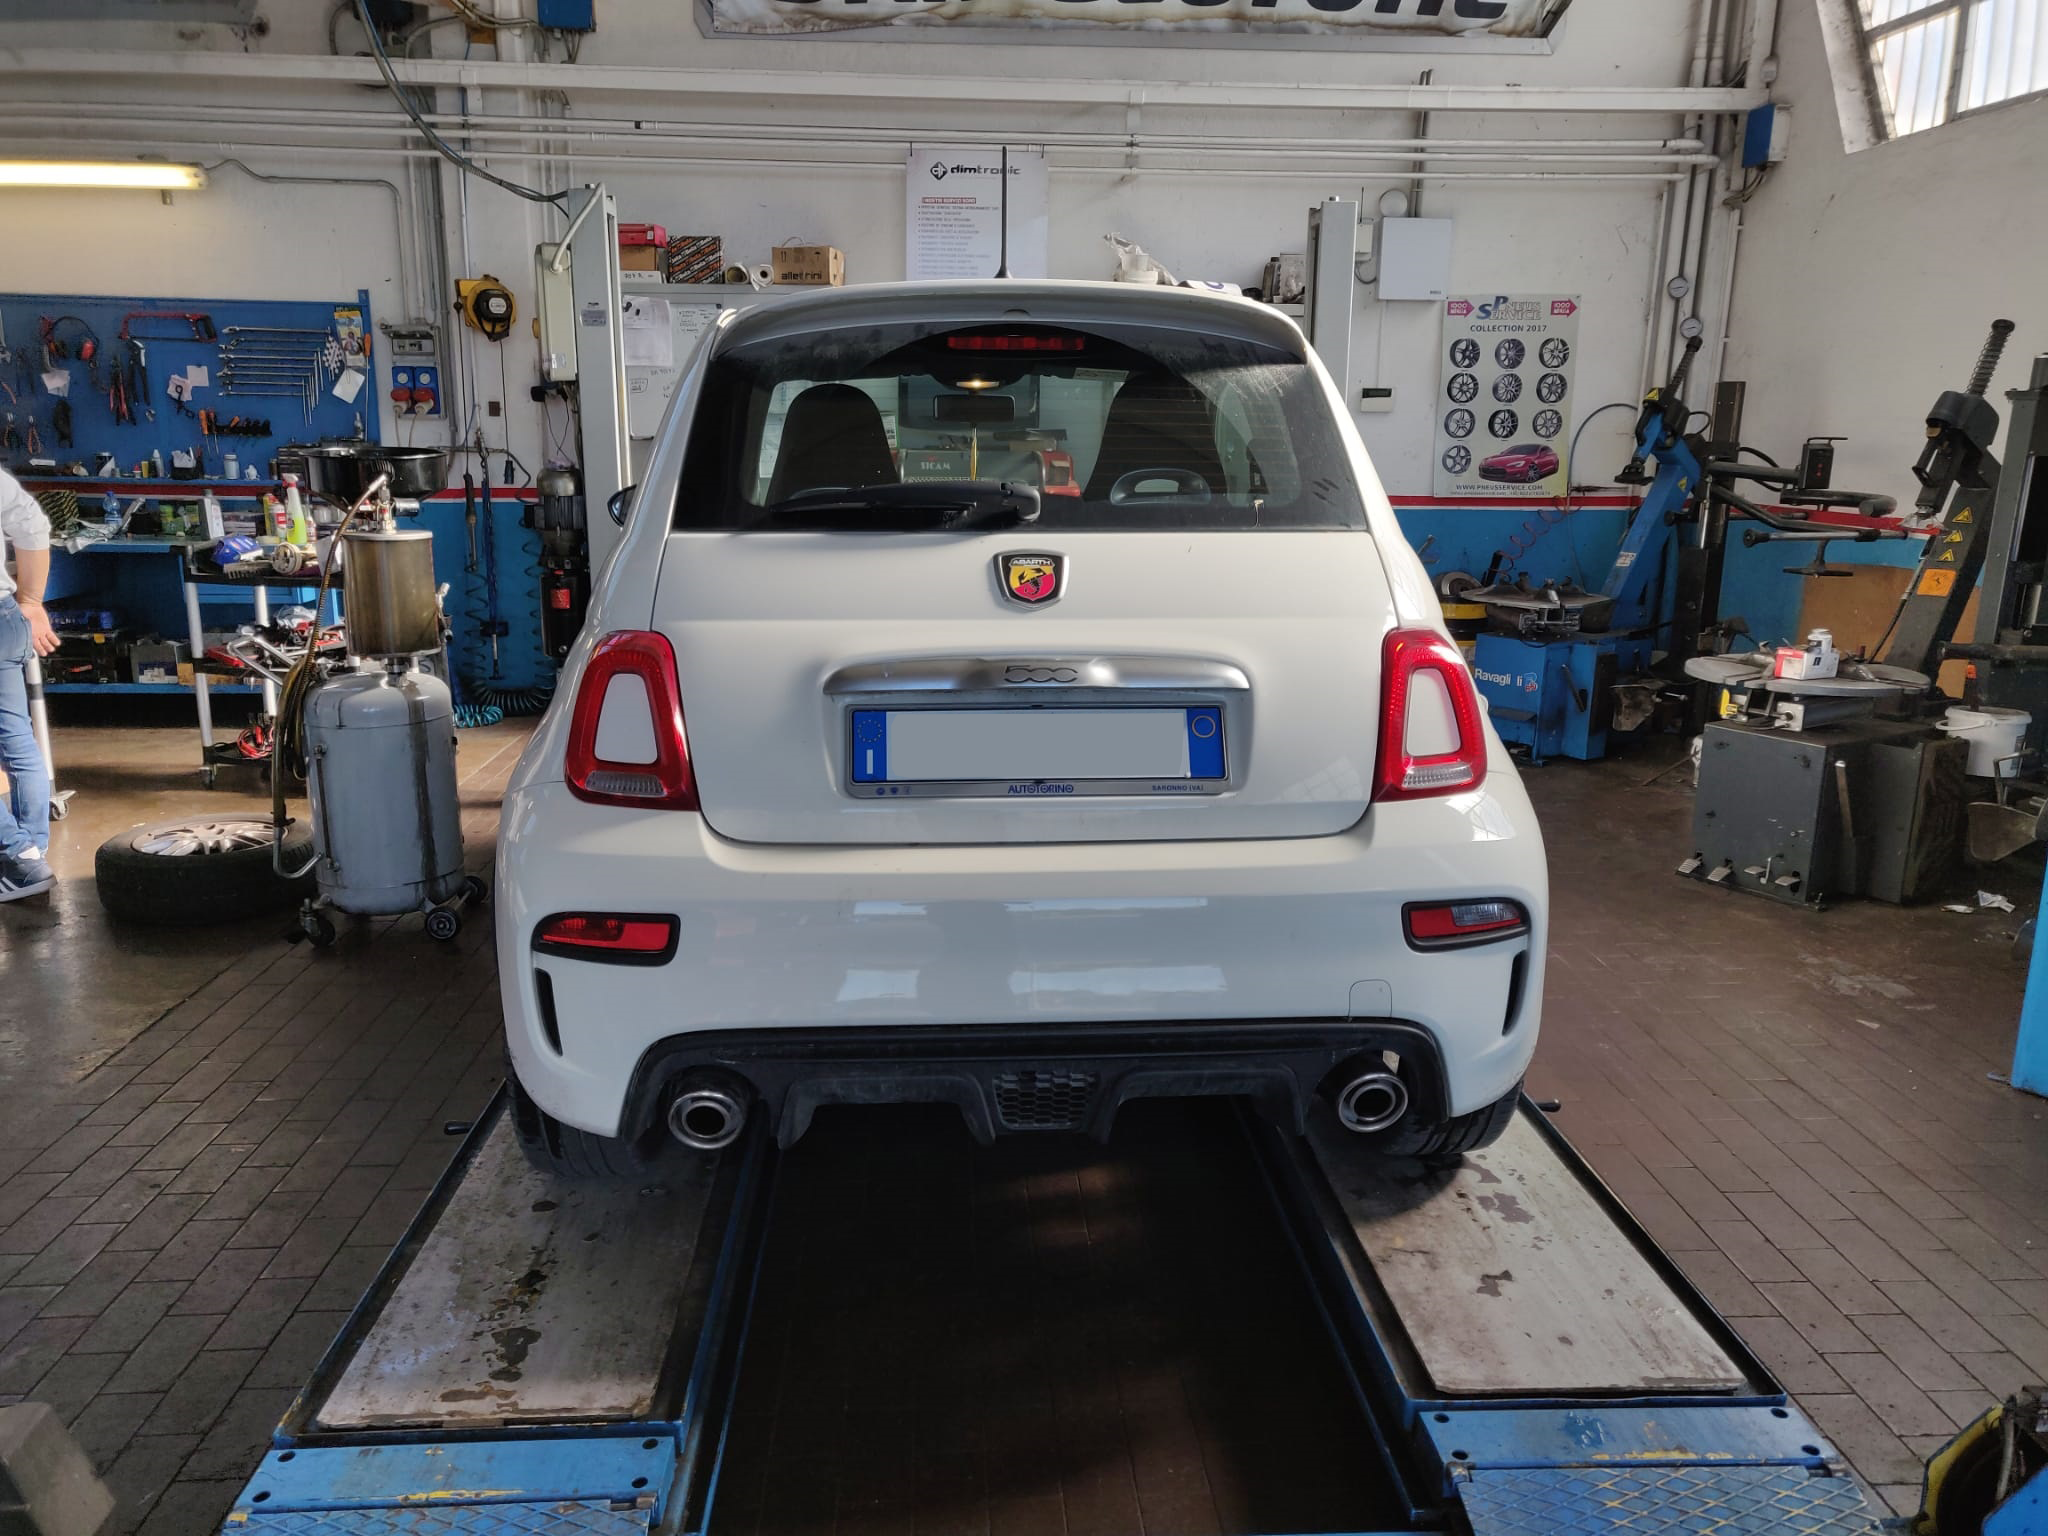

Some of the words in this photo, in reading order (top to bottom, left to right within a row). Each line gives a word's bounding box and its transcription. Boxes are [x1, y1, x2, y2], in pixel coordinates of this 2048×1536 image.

[1476, 304, 1541, 320] SERVICE
[1470, 325, 1524, 333] COLLECTION
[1526, 325, 1547, 333] 2017
[1007, 784, 1074, 794] AUTOTORINO
